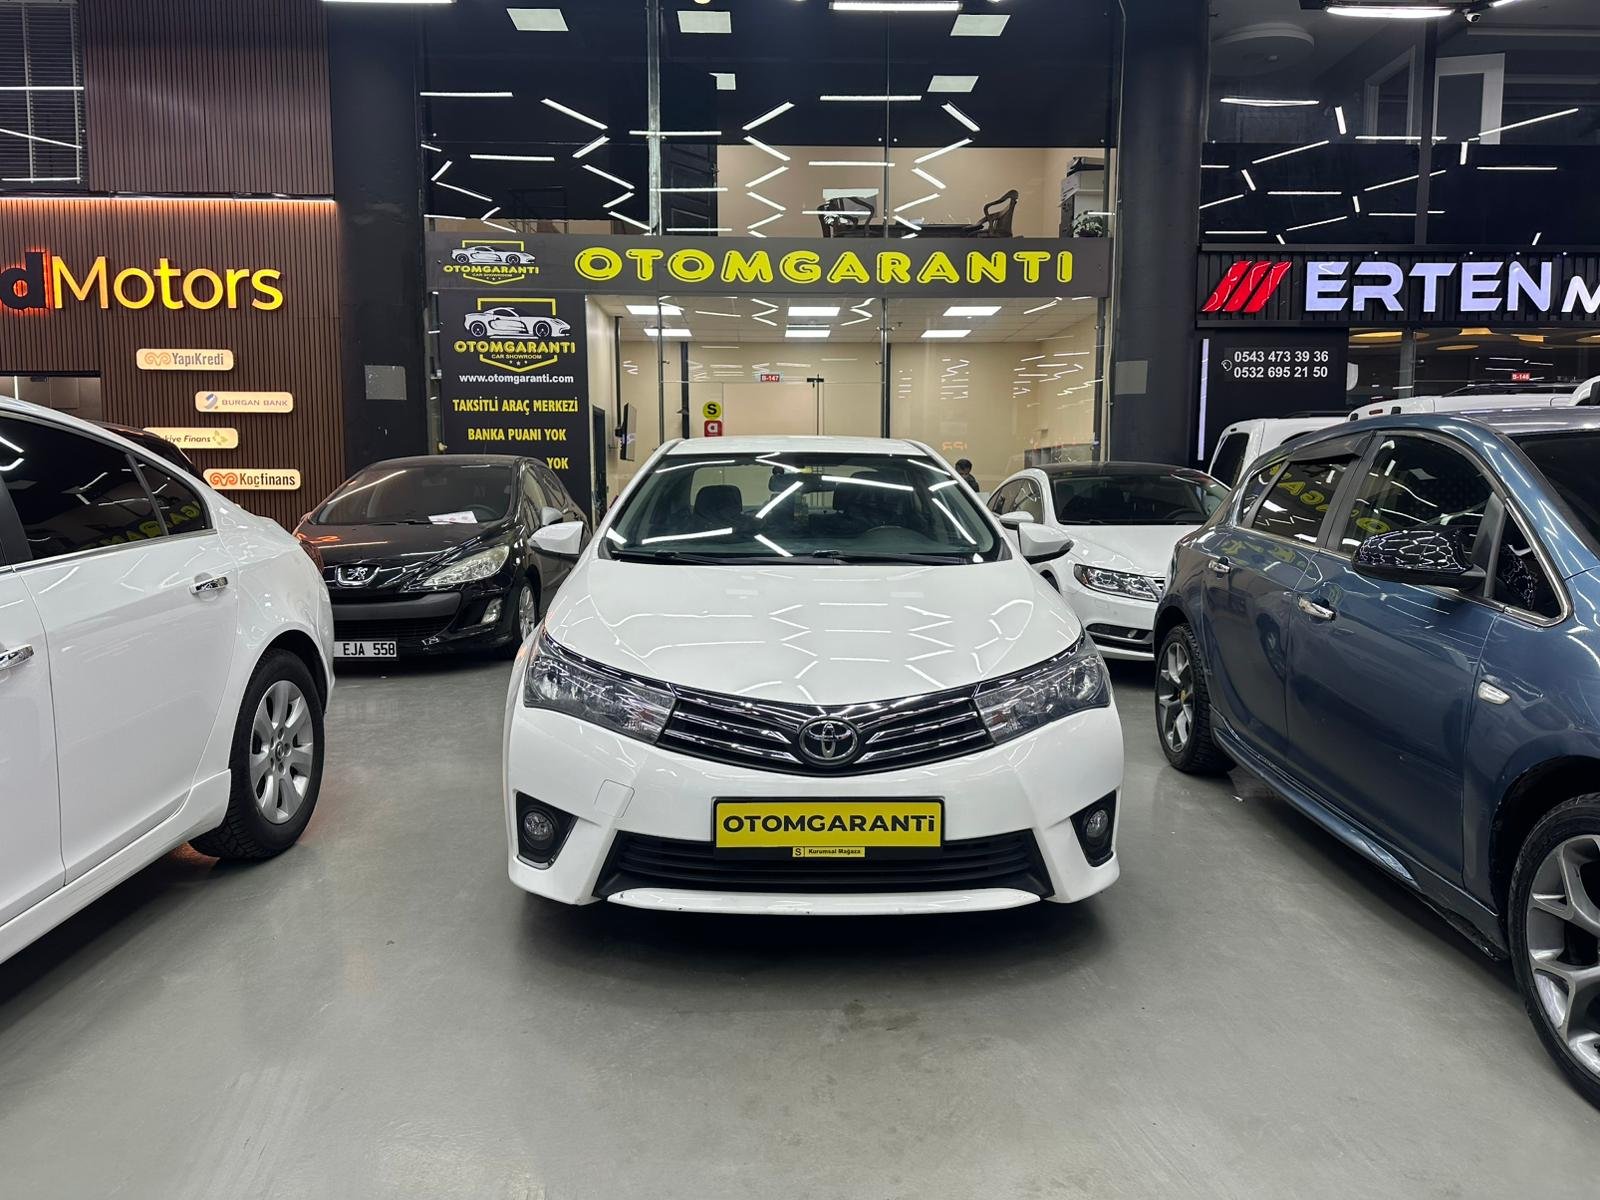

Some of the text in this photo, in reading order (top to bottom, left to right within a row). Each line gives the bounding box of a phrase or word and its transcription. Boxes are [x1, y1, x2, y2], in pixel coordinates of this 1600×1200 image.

[443, 265, 540, 274] OTOMGARANTI
[574, 246, 1073, 284] OTOMGARANTI
[1305, 260, 1552, 312] ERTEN
[453, 341, 576, 353] OTOMGARANTI
[1234, 351, 1329, 363] 0543 473 39 36
[1233, 366, 1328, 378] 0532 695 21 50
[459, 374, 574, 384] www.otomgaranti.com
[263, 399, 288, 407] BANK
[452, 397, 579, 415] TAKSİTLİ ARAÇ MERKEZİ
[707, 403, 717, 415] S
[183, 435, 211, 443] Finans
[467, 428, 567, 441] BANKA PUANI YOK
[547, 457, 569, 470] YOK
[239, 472, 296, 487] Koçfinans
[343, 642, 396, 656] EJA 558
[795, 847, 802, 856] S
